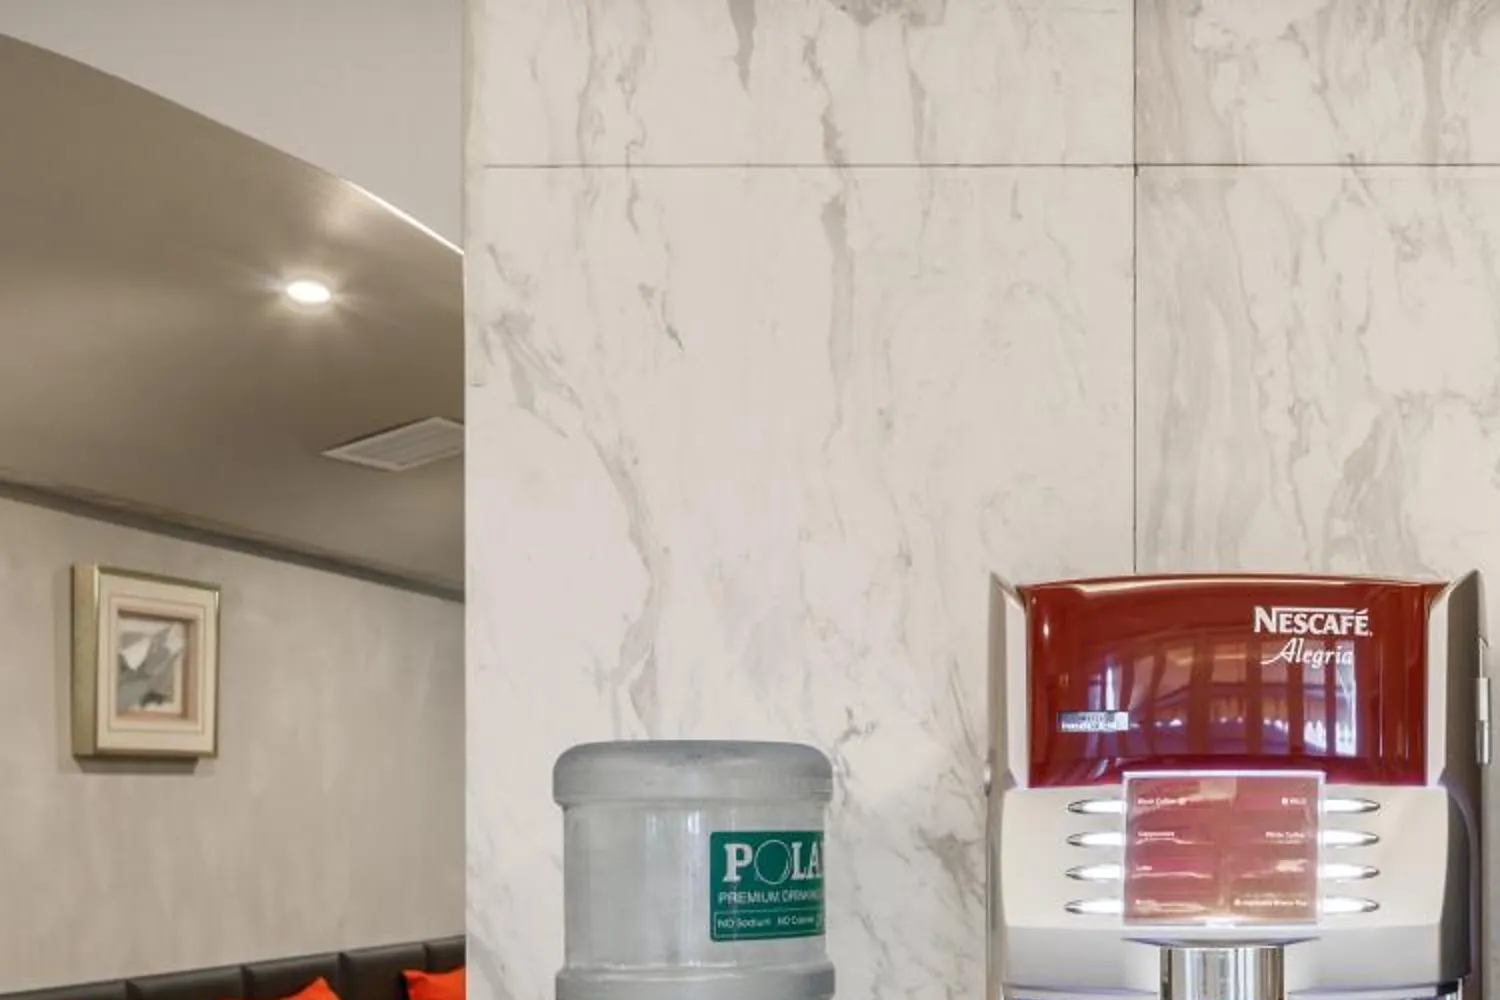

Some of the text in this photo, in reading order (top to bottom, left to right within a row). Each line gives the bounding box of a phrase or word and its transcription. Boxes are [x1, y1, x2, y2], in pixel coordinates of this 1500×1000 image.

[1253, 605, 1371, 637] NESCAFÉ
[1260, 637, 1353, 668] Alegria
[722, 839, 824, 885] POLA
[718, 889, 780, 905] PREMIUM
